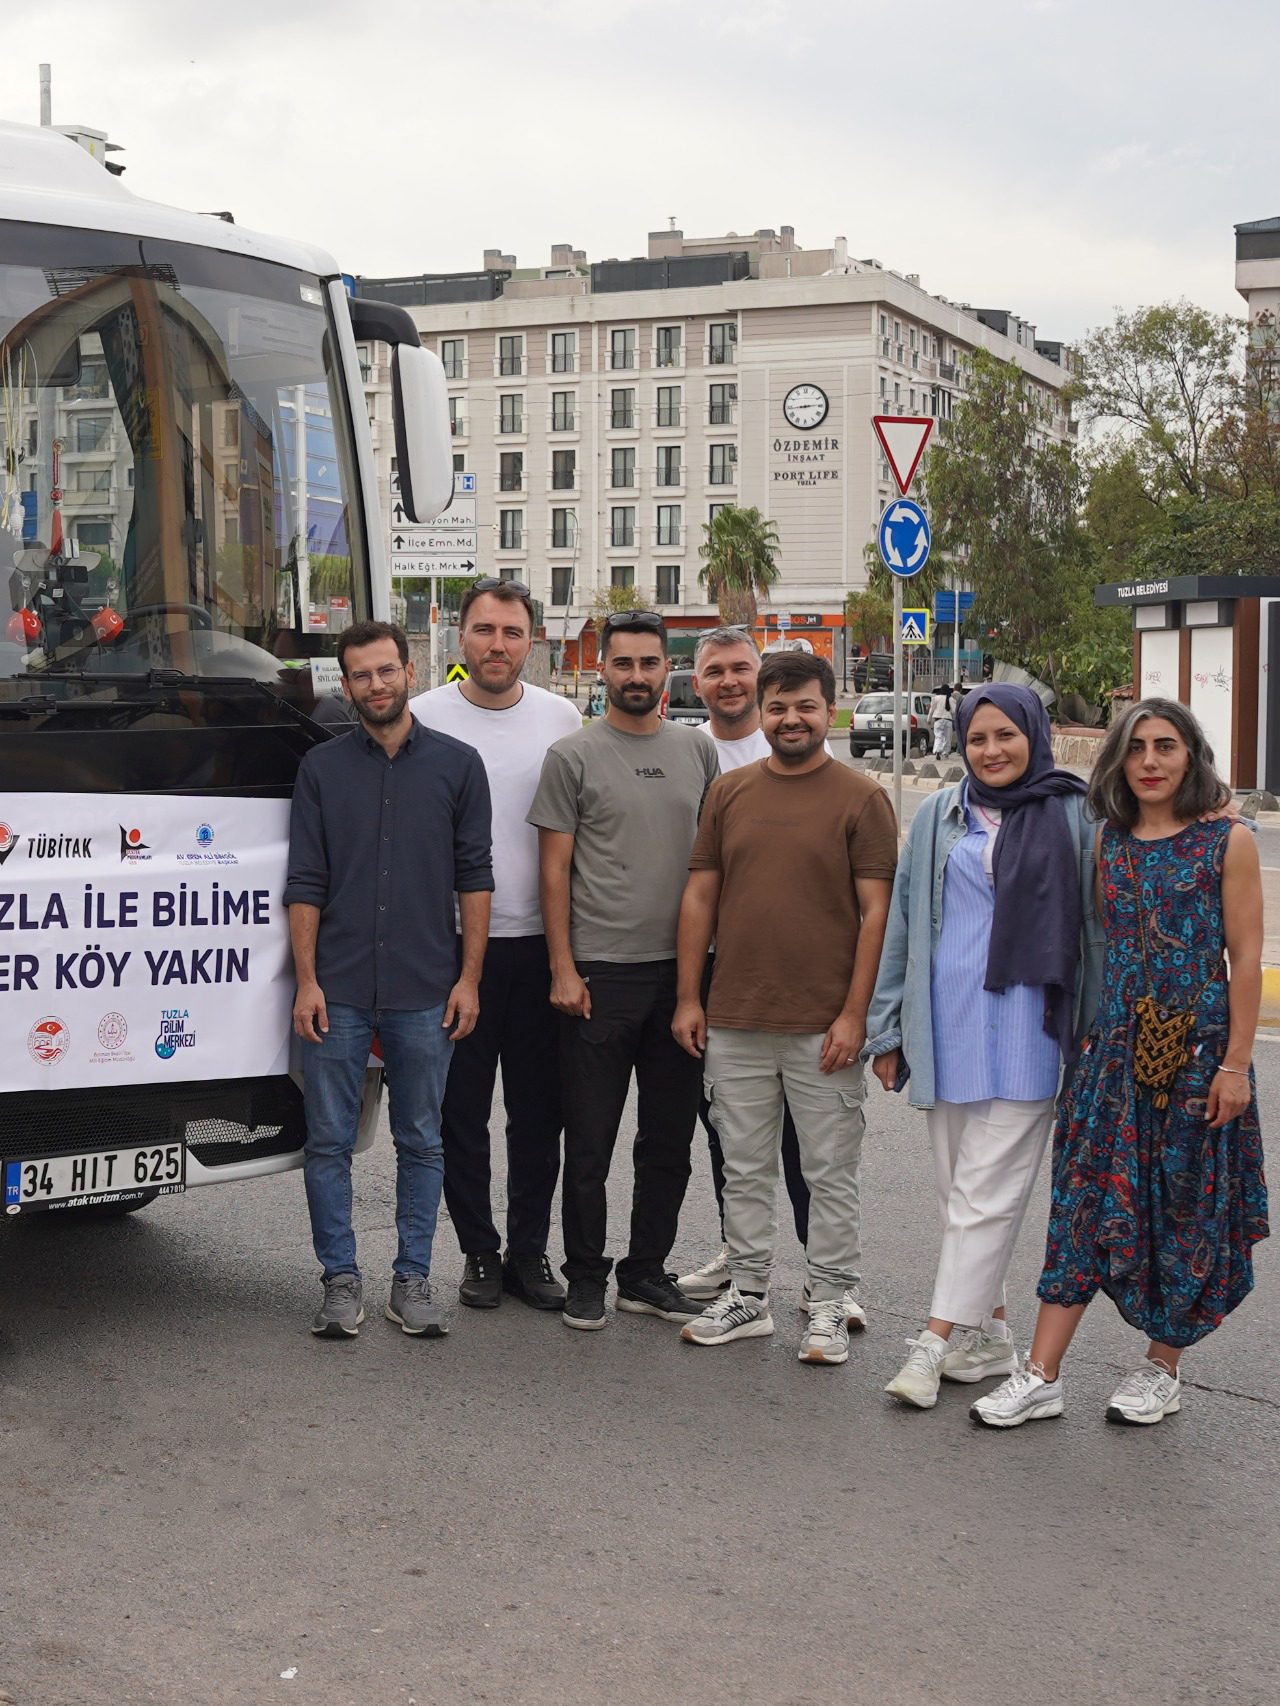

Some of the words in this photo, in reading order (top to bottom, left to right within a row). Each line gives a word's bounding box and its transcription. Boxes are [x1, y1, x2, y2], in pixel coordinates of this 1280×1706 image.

[773, 437, 839, 452] ÖZDEMİR
[773, 471, 805, 480] PORT
[809, 470, 838, 479] LIFE
[451, 517, 474, 525] Mah.
[408, 536, 426, 548] İlçe
[428, 538, 455, 547] Emn.
[456, 538, 474, 547] Md.
[394, 562, 415, 571] Halk
[418, 562, 438, 573] Eğt.
[439, 562, 461, 571] Mrk.
[1117, 587, 1135, 598] TUZLA
[1136, 580, 1169, 595] BELEDİYESİ
[27, 832, 93, 859] TÜBİTAK
[83, 883, 139, 928] İLE
[152, 882, 270, 927] BİLİME
[55, 944, 131, 990] KÖY
[144, 948, 250, 986] YAKIN
[161, 1009, 189, 1019] TUZLA
[164, 1030, 196, 1048] MERKEZİ
[22, 1162, 54, 1198] 34
[71, 1154, 118, 1192] HIT
[134, 1146, 179, 1184] 625
[7, 1185, 19, 1197] TR
[158, 1186, 170, 1195] 444
